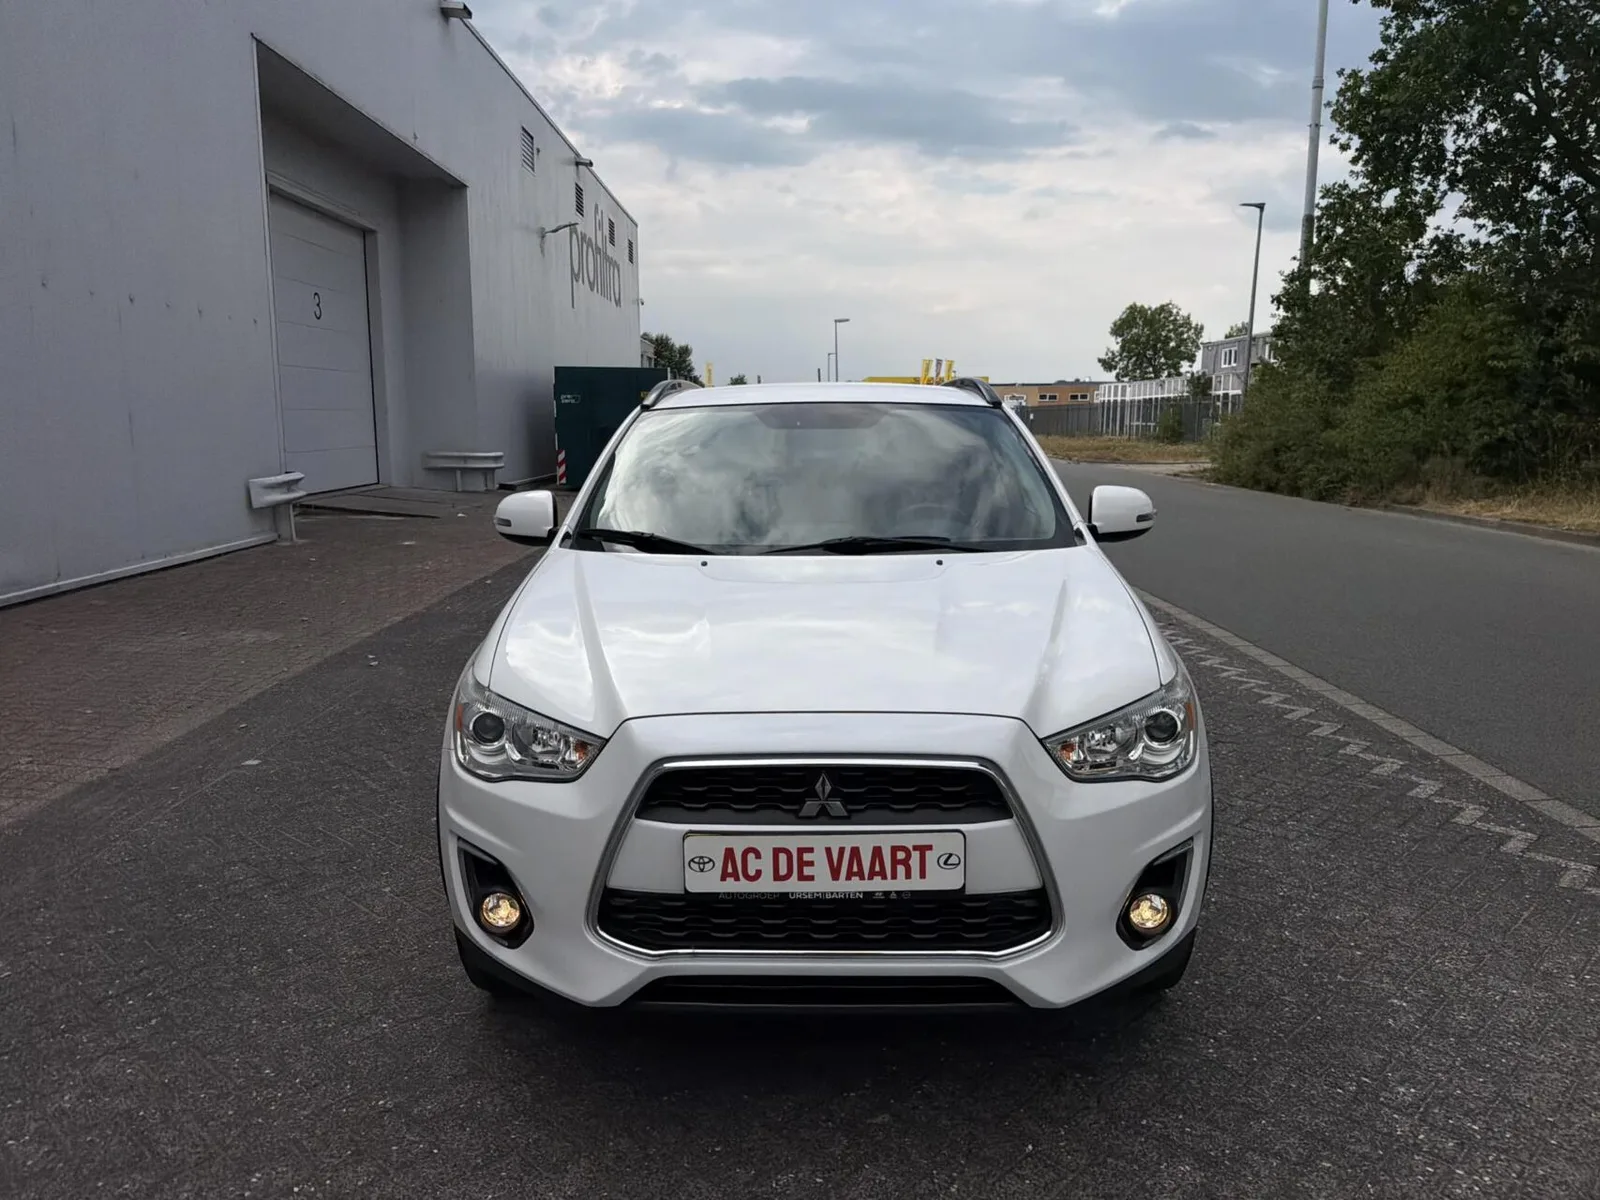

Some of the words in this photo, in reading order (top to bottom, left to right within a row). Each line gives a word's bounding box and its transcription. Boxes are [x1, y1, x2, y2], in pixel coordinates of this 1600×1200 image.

[569, 202, 621, 309] profiltra
[313, 292, 322, 320] 3
[719, 847, 762, 882] AC
[772, 847, 815, 882] DE
[825, 845, 933, 882] VAART
[718, 892, 780, 900] AUTOGROEP
